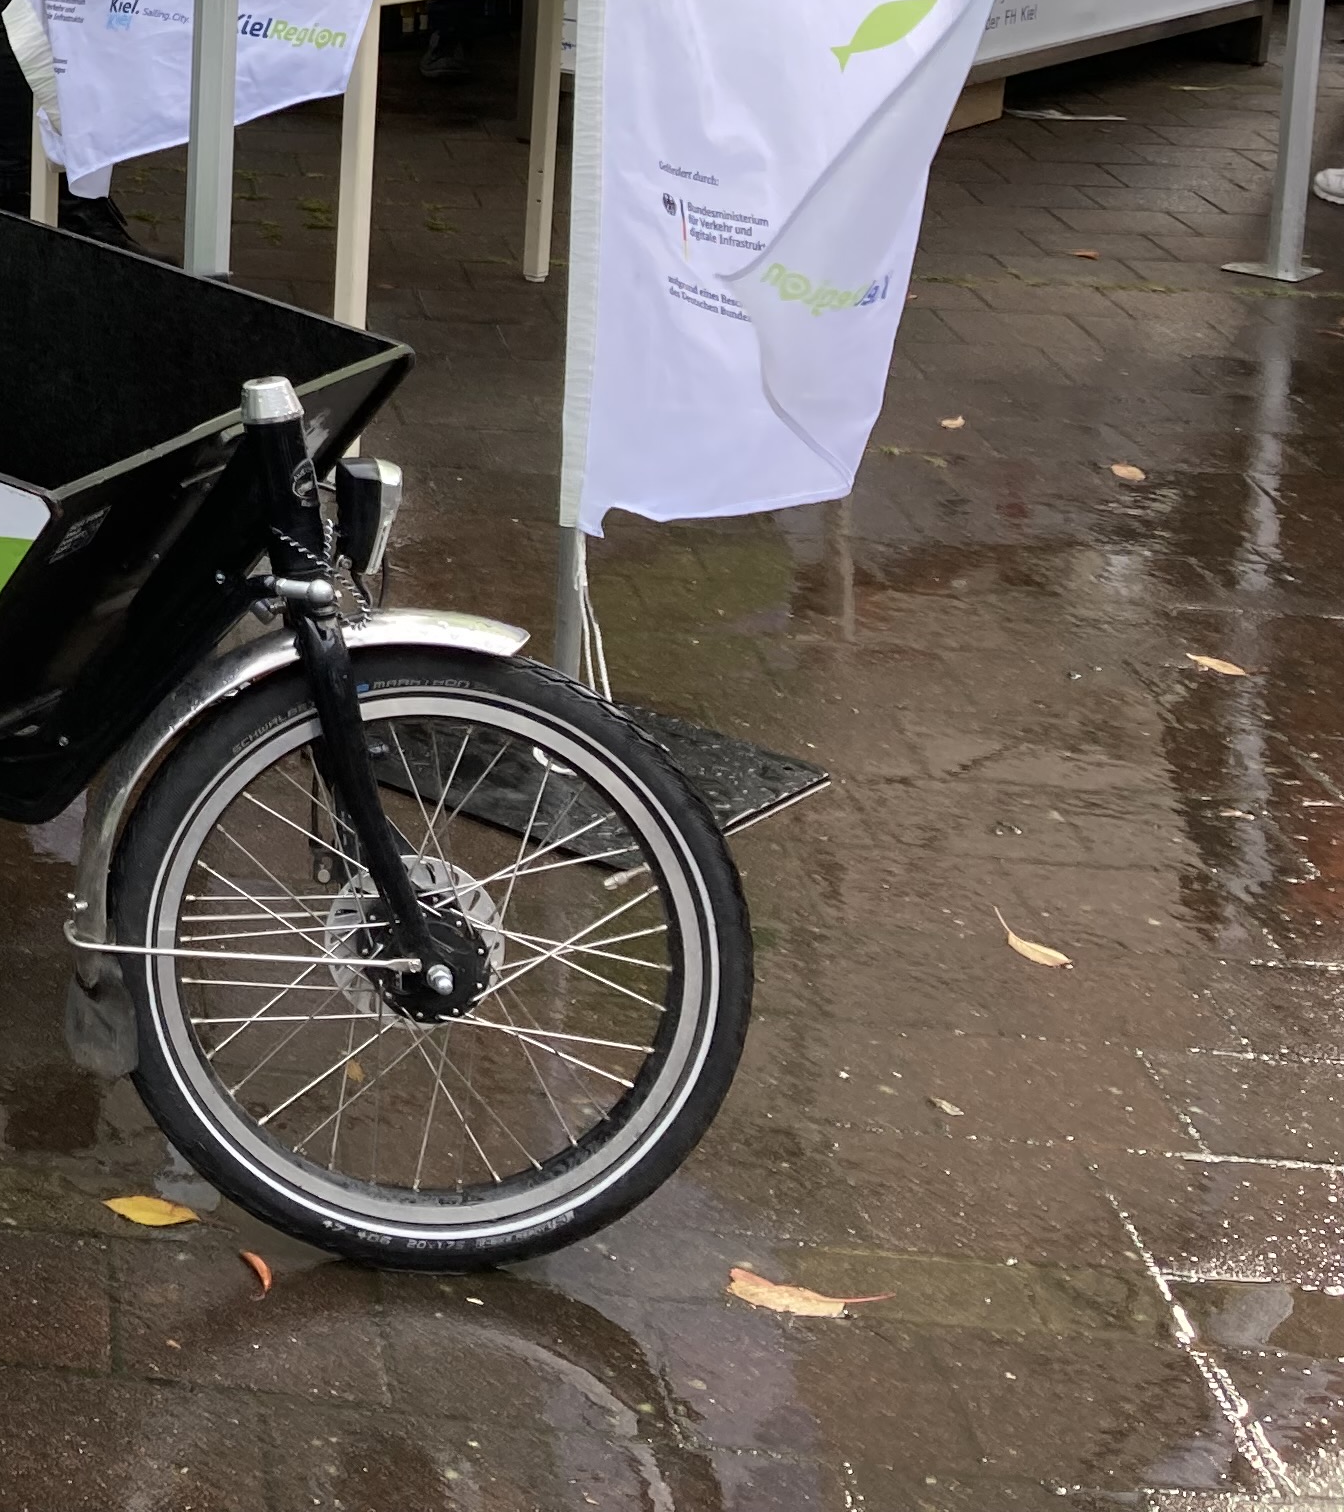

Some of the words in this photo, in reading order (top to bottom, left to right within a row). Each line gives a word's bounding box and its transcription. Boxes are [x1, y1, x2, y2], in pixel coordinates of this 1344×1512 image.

[1004, 8, 1017, 26] FH
[1020, 4, 1038, 21] Kiel
[693, 171, 720, 187] durch:
[687, 202, 769, 227] Bundesministerium
[688, 214, 700, 226] für
[700, 217, 733, 233] Verkehr
[735, 226, 753, 237] und
[719, 235, 766, 251] Infrastruk
[682, 292, 718, 314] Deutschen
[721, 294, 743, 308] Besc
